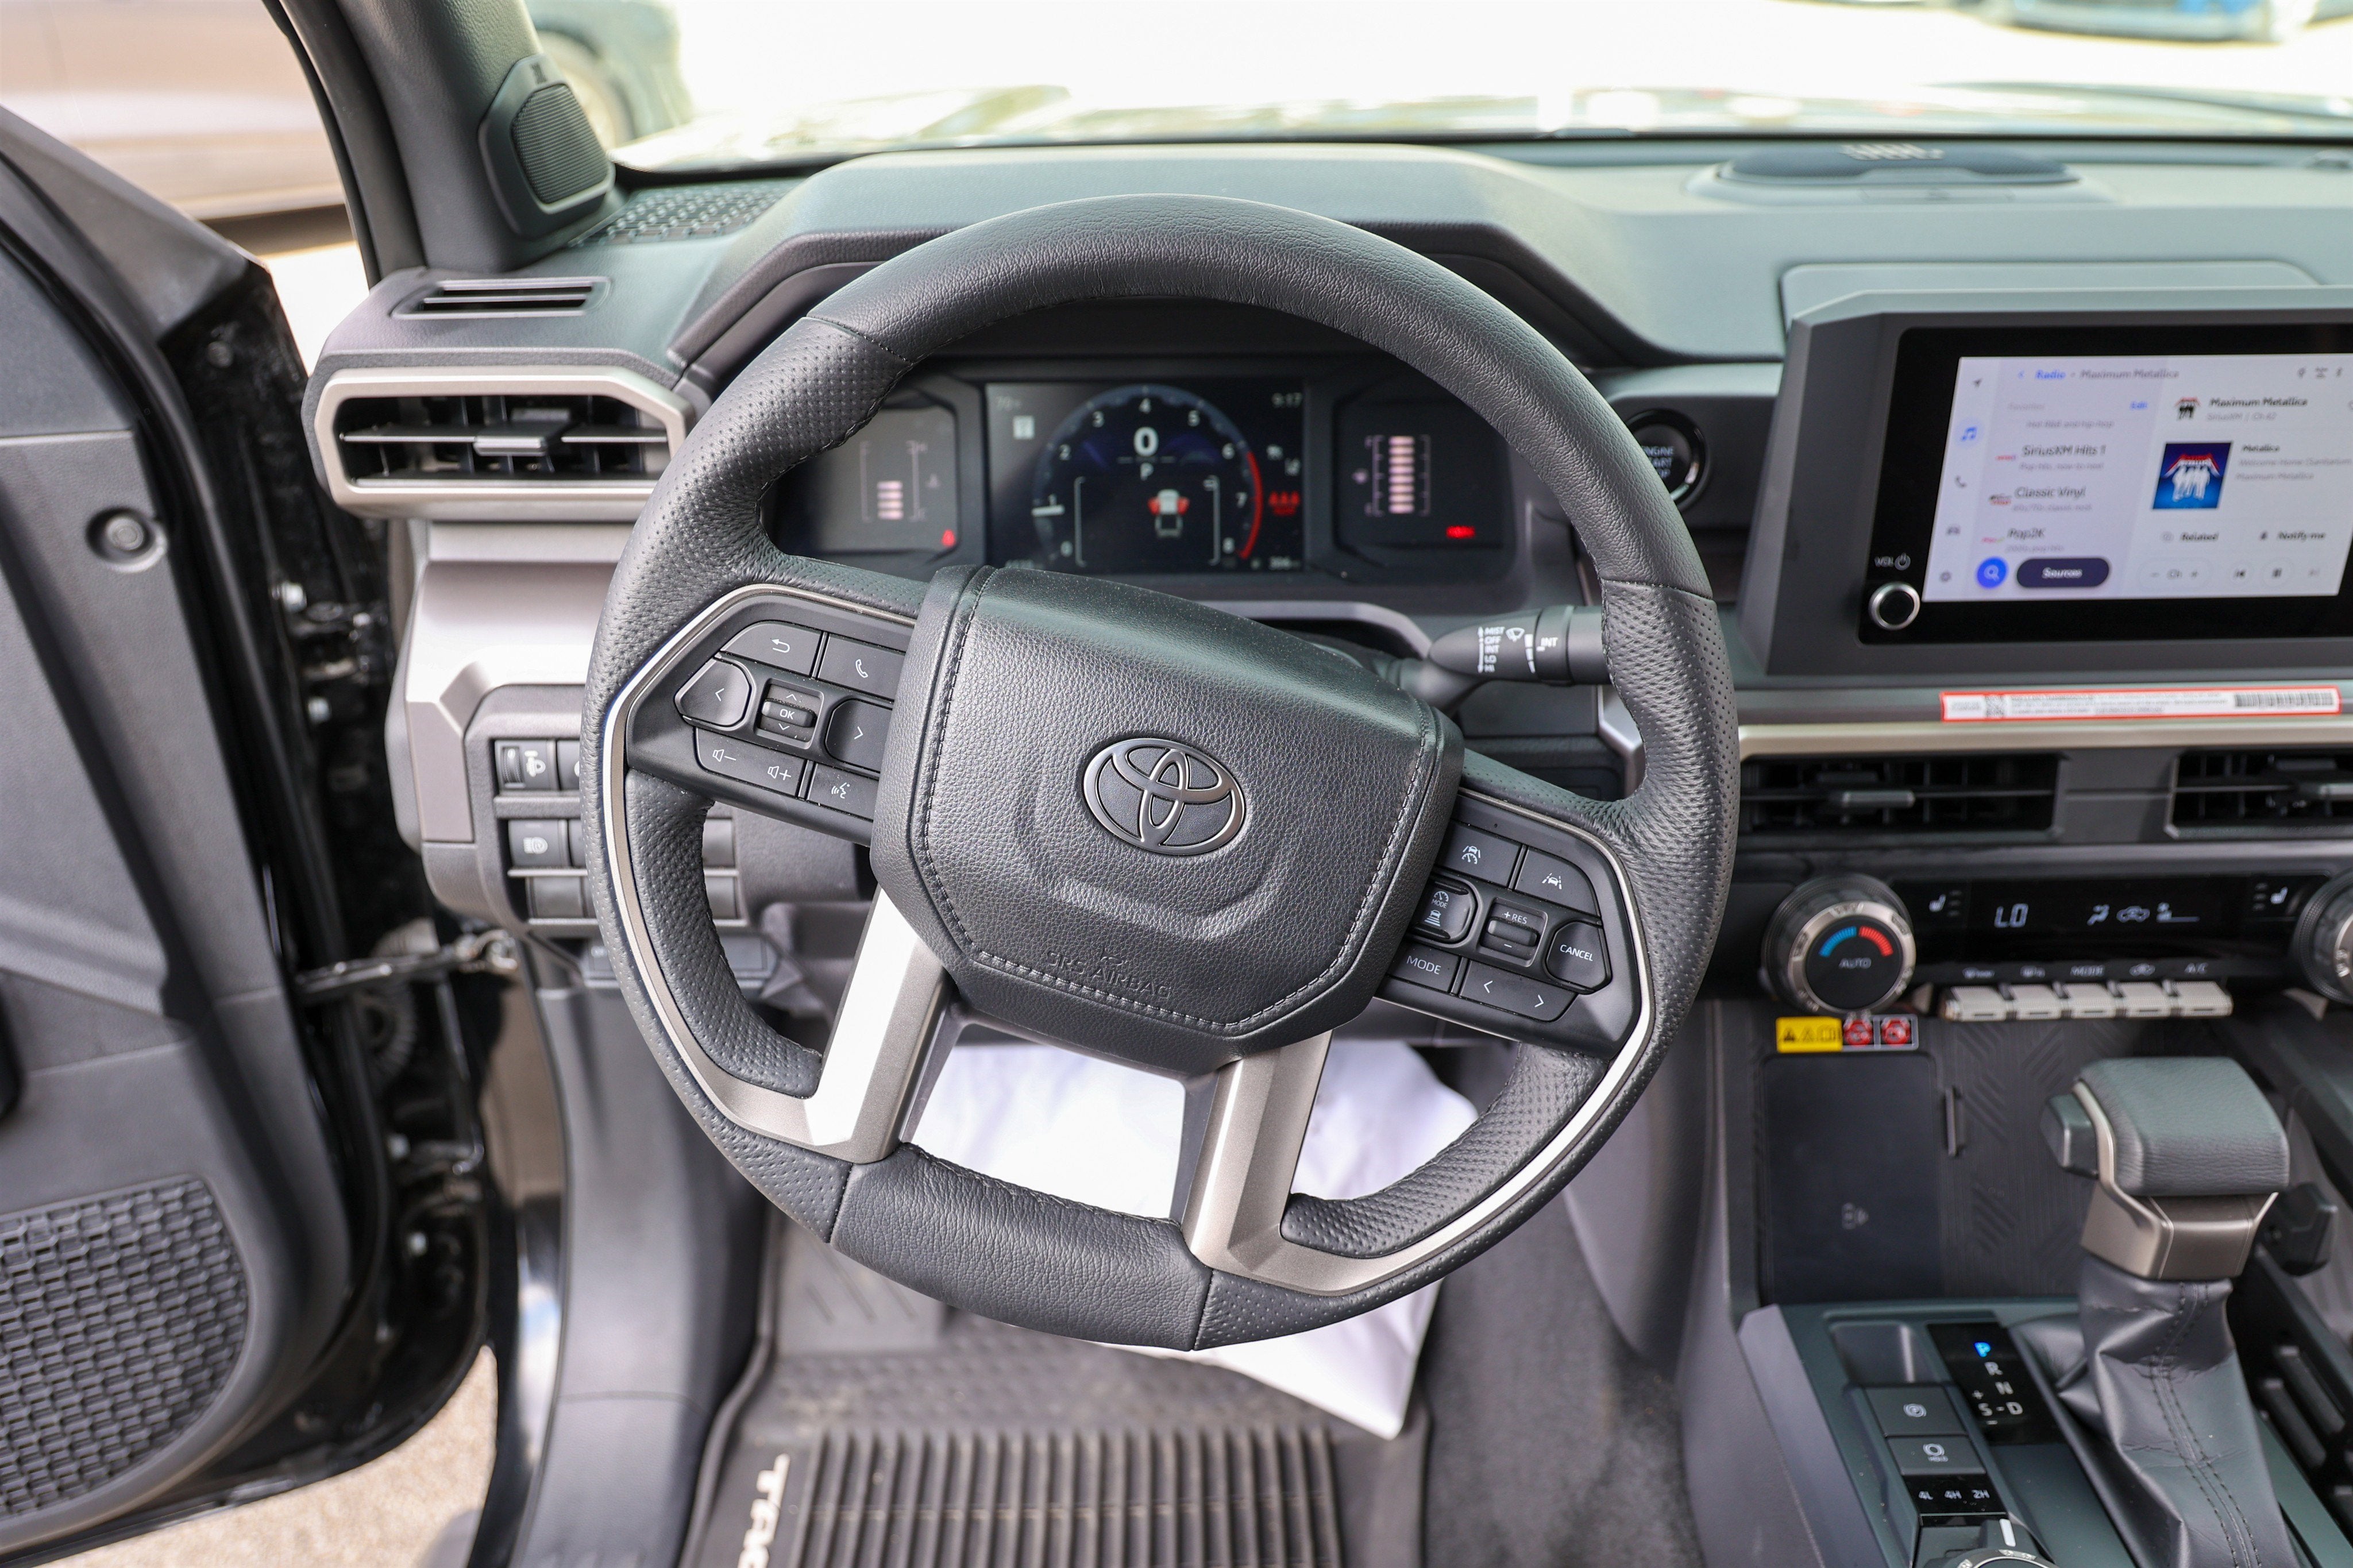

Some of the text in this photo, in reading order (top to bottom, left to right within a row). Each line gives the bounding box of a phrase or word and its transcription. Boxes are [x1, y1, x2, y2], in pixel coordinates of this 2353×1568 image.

[2035, 368, 2179, 380] Radio Maximum Metallica
[1139, 398, 1151, 414] 4
[2129, 401, 2148, 410] Edit
[2209, 397, 2260, 407] Maximum
[2262, 396, 2308, 406] Metallica
[1093, 411, 1105, 427] 3
[2205, 413, 2243, 422] SiriusXM
[1133, 426, 1159, 457] 0
[1059, 443, 1071, 460] 2
[1221, 443, 1235, 459] 6
[1641, 446, 1674, 457] NGINE
[2022, 445, 2073, 456] SiriusXM
[2074, 445, 2099, 455] Hits
[2242, 444, 2280, 453] Metallica
[1140, 462, 1154, 481] P
[2236, 472, 2315, 481] Maximum Metallica
[2015, 485, 2086, 499] Classic Vinyl
[1235, 491, 1248, 508] 7
[2007, 527, 2045, 540] Pop2K
[2180, 532, 2219, 541] Related
[2277, 531, 2308, 542] Notify
[1874, 556, 1893, 567] VOL
[2042, 567, 2083, 579] Sources
[1484, 626, 1505, 636] MIST
[1484, 635, 1501, 645] OFF
[1540, 637, 1559, 647] INT
[1484, 644, 1500, 654] INT
[1484, 655, 1497, 664] LO
[779, 708, 794, 720] OK
[1431, 899, 1448, 909] MODE
[1511, 913, 1527, 924] RES
[1993, 903, 2029, 929] LO
[1559, 944, 1594, 962] CANCEL
[1406, 955, 1442, 975] MODE
[1838, 957, 1872, 969] AUTO
[1047, 950, 1172, 999] SRS AIRBAG
[1974, 1342, 1992, 1358] P
[1984, 1361, 2004, 1376] R
[1995, 1381, 2014, 1395] N
[1978, 1401, 2024, 1417] S D
[1918, 1489, 1991, 1500] 4L 4H 2H
